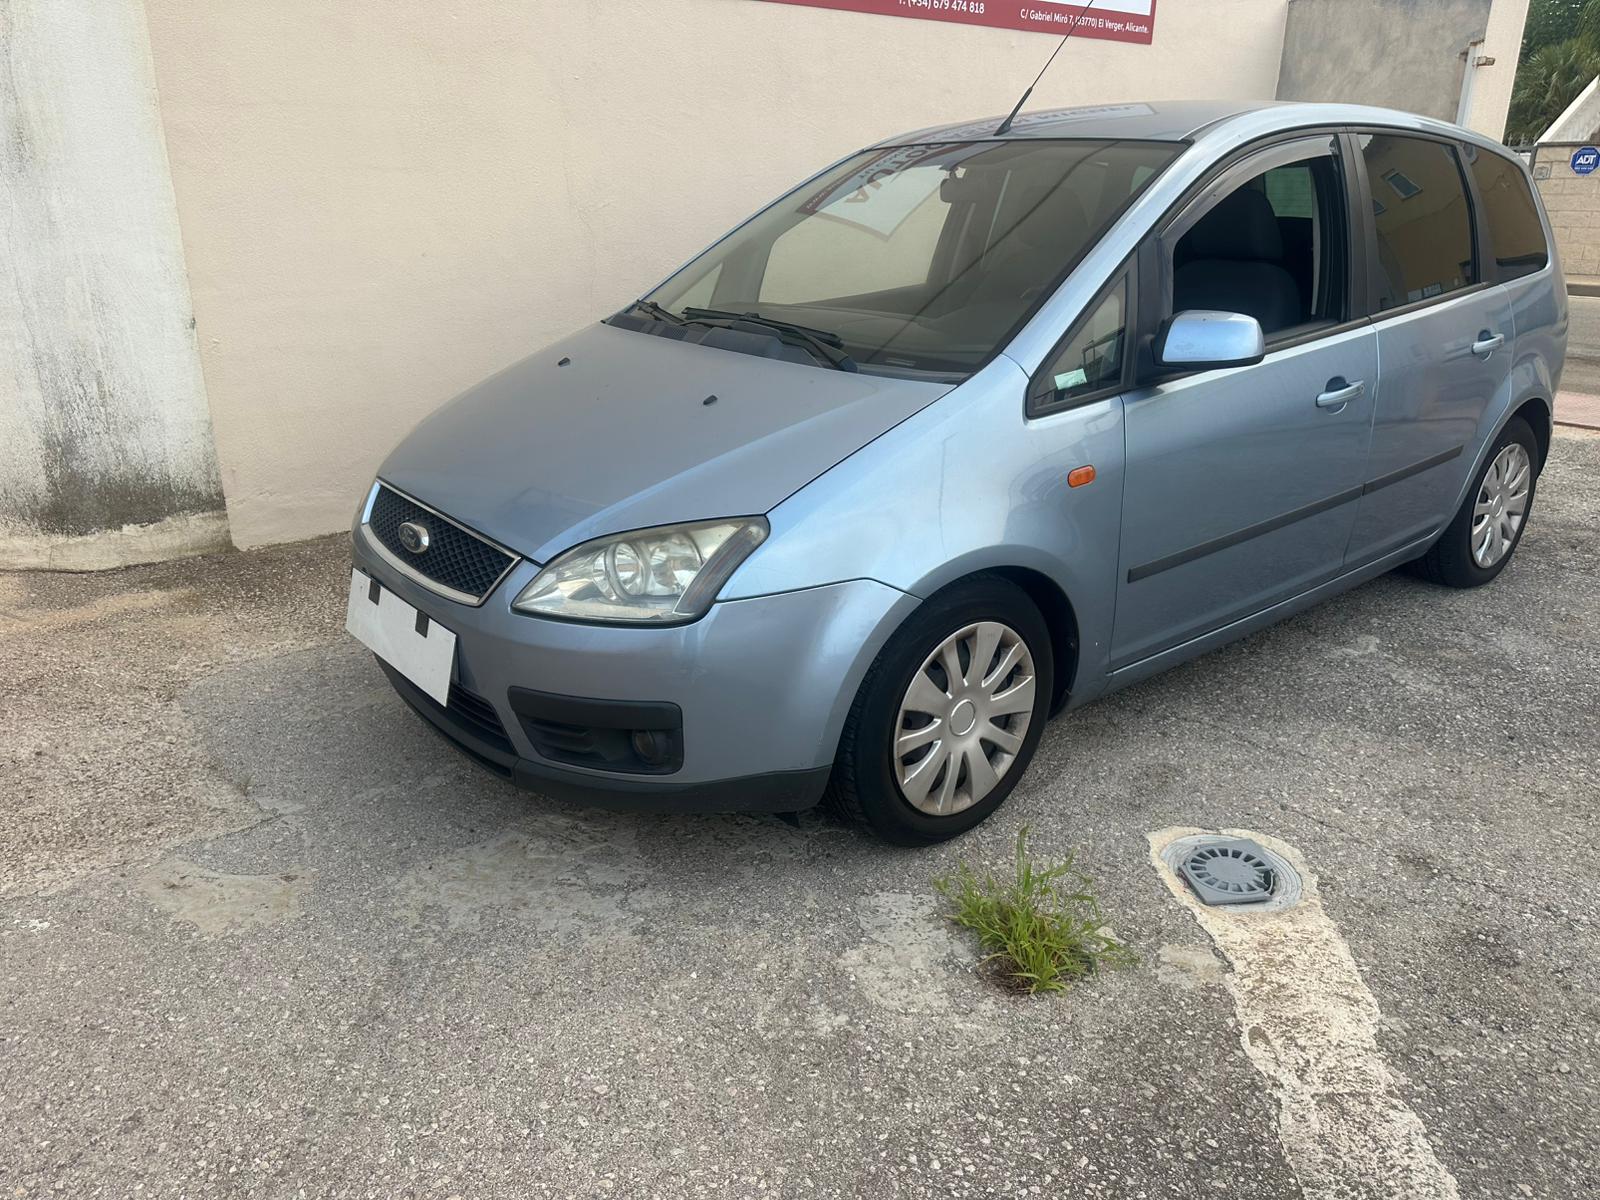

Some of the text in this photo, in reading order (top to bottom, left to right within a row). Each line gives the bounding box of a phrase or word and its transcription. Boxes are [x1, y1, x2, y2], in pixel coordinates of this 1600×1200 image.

[933, 0, 950, 10] 679
[951, 1, 967, 12] 474
[969, 2, 985, 14] 818
[1020, 9, 1029, 19] C/
[1029, 10, 1052, 21] Gabriel
[1053, 13, 1068, 23] Miró
[1069, 15, 1074, 25] 7,
[1098, 18, 1104, 28] El
[1105, 20, 1125, 32] Verger,
[1576, 154, 1597, 165] ADT
